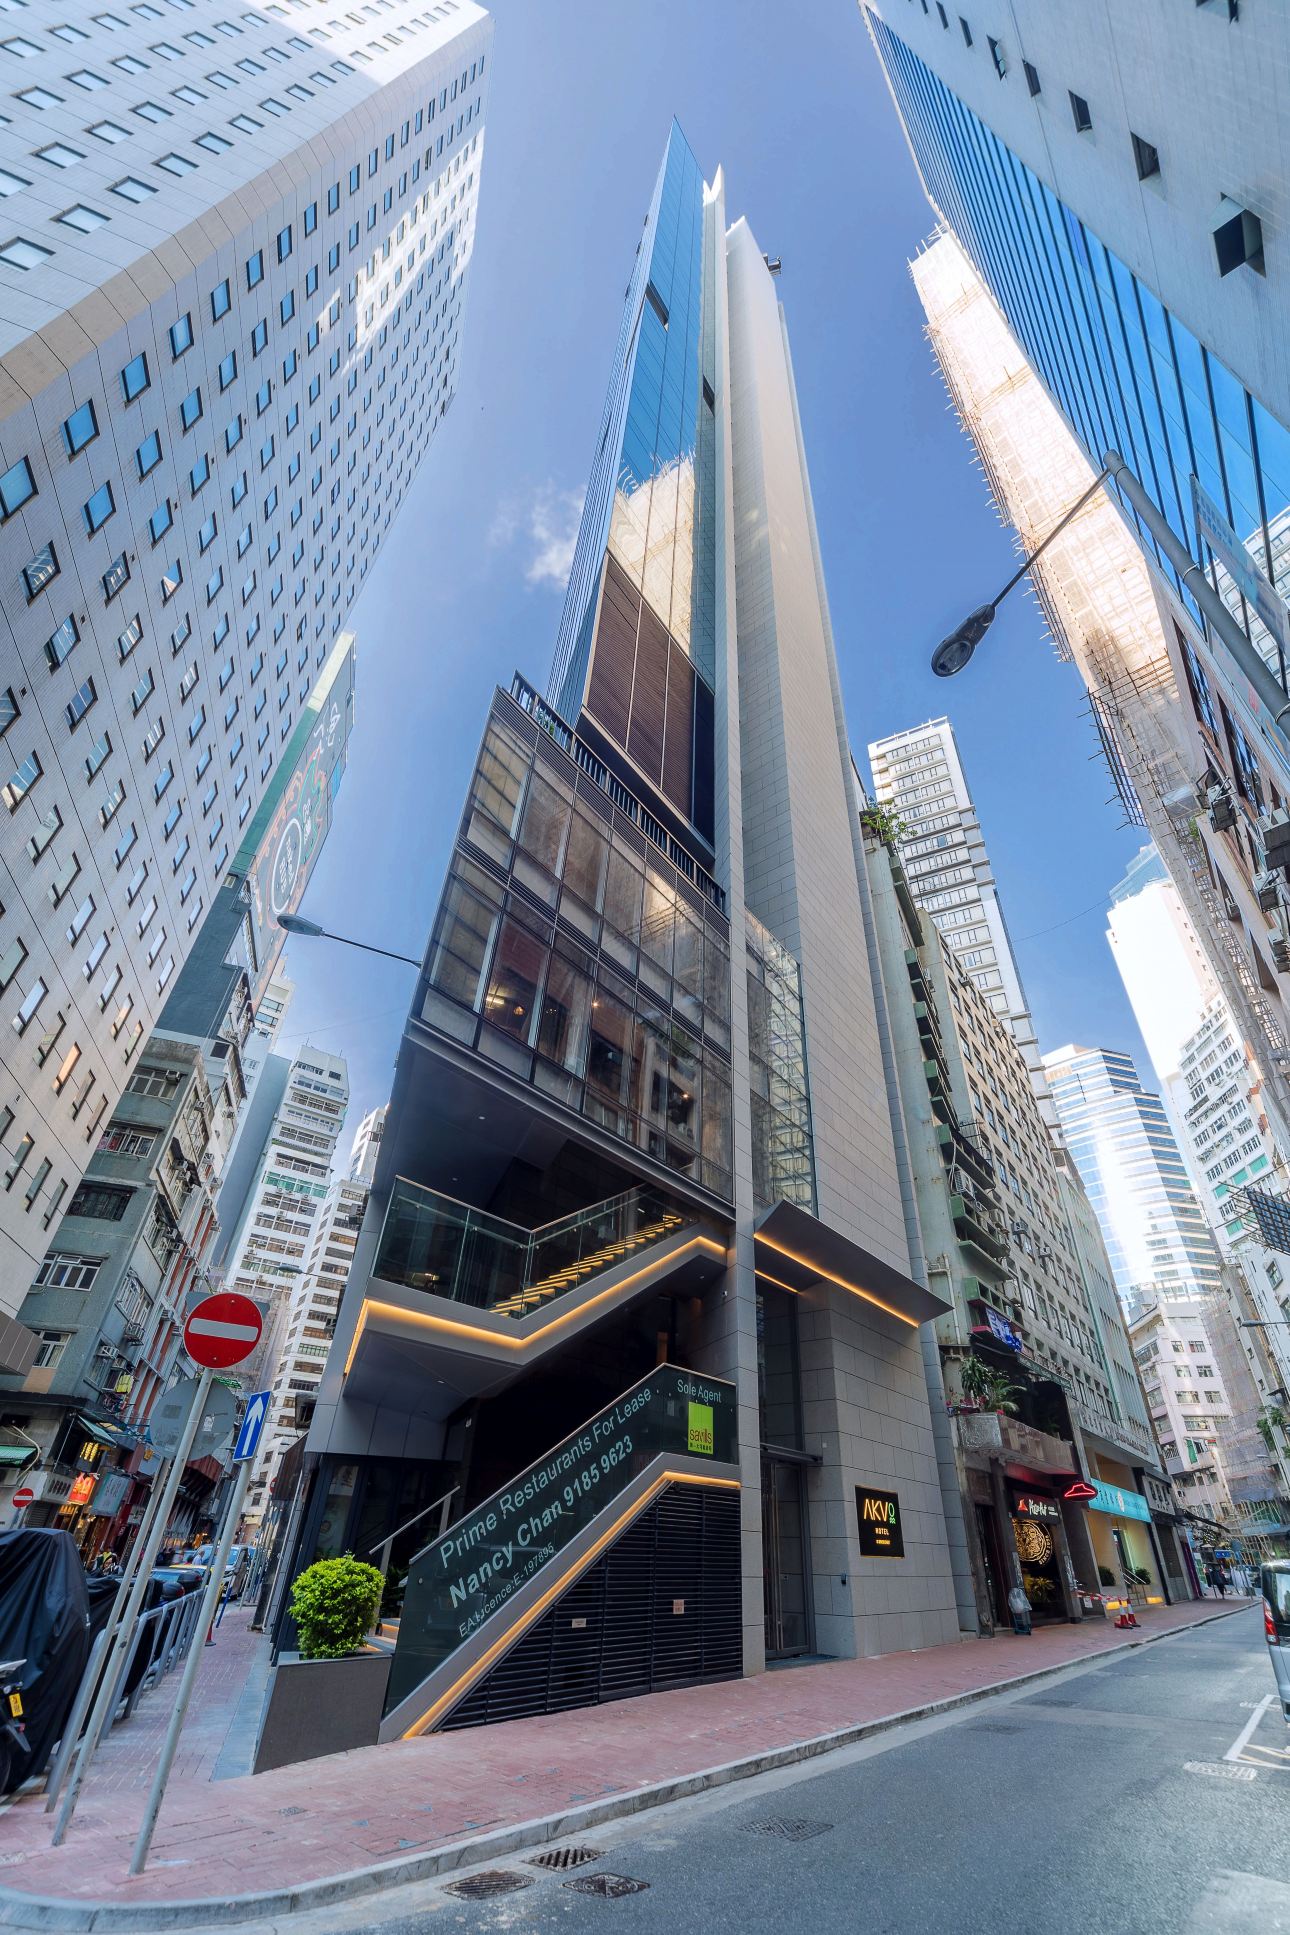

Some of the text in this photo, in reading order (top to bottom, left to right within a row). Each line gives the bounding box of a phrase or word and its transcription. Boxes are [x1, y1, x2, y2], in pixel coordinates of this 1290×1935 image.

[678, 1379, 722, 1403] Sole Agent
[439, 1388, 652, 1569] Prime Restaurants For Lease
[449, 1435, 633, 1609] Nancy Chan 9185 9623
[863, 1498, 895, 1522] AKVO
[459, 1617, 476, 1637] EA
